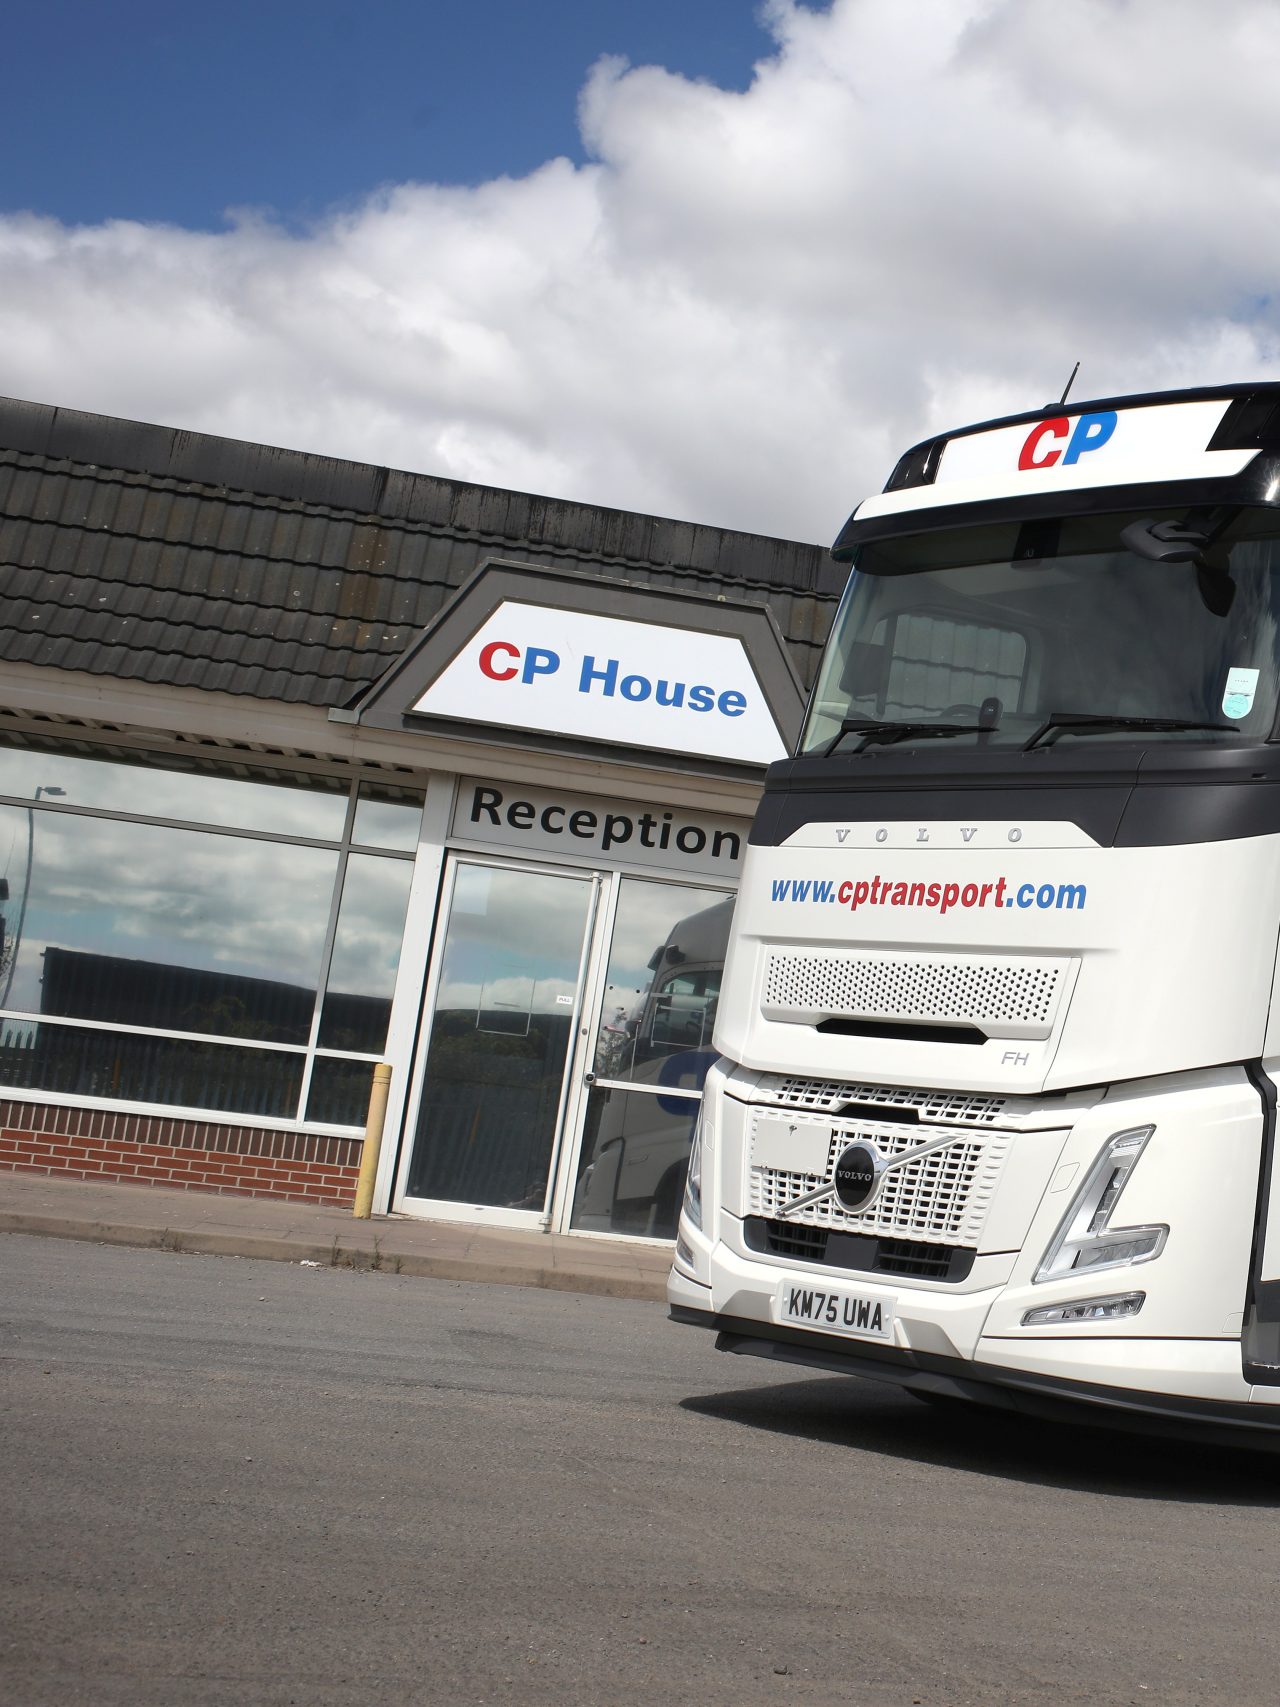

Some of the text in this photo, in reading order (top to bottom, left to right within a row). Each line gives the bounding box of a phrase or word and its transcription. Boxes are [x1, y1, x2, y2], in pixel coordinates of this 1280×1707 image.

[1018, 411, 1118, 471] CP
[479, 641, 748, 717] CP House
[470, 786, 741, 860] Reception
[836, 827, 1022, 843] VOLVO
[771, 875, 1087, 914] www.cptransport.com
[1001, 1051, 1030, 1066] FH
[837, 1170, 872, 1182] VOLVO
[788, 1288, 882, 1332] KM75 UWA
